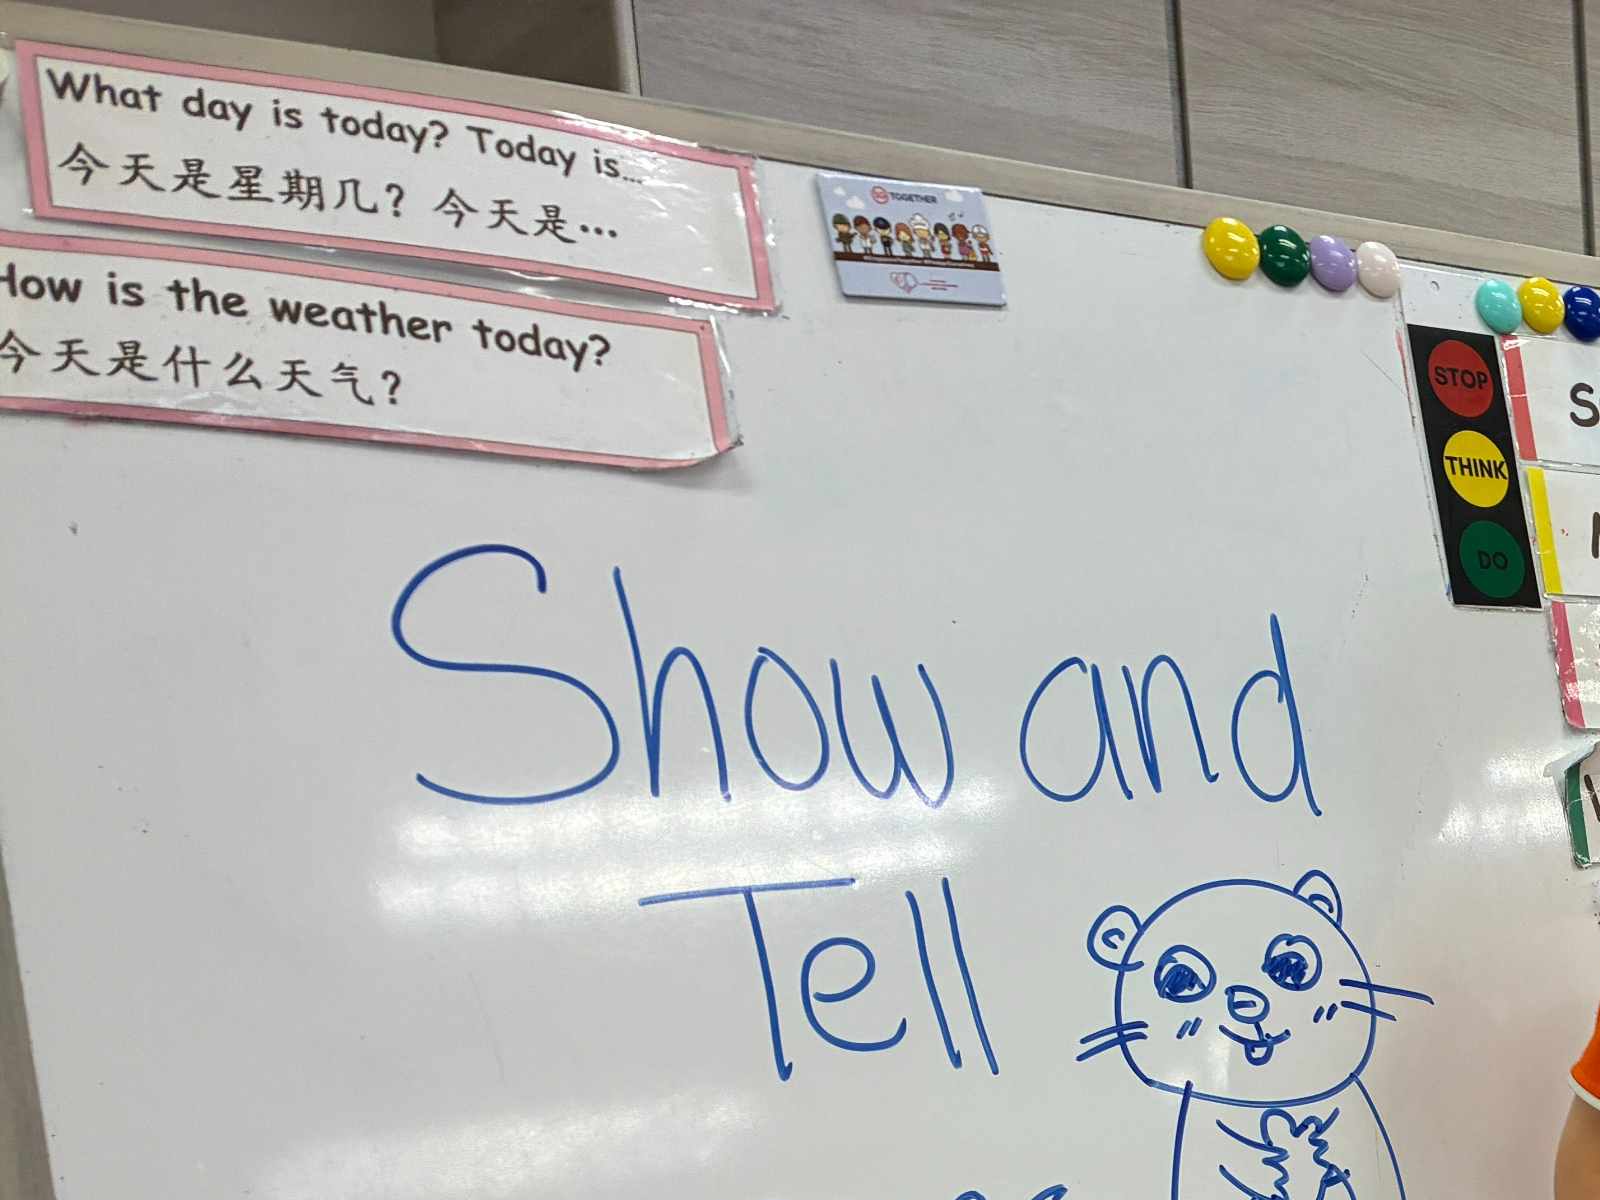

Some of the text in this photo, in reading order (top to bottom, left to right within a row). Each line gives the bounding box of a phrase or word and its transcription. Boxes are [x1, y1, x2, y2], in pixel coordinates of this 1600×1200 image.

[45, 67, 162, 113] What
[182, 87, 253, 132] day
[272, 98, 304, 130] is
[320, 106, 450, 151] today?
[466, 124, 577, 177] Today
[107, 270, 146, 308] is
[167, 277, 249, 318] the
[269, 297, 453, 344] weather
[471, 318, 612, 368] today?
[1434, 366, 1488, 391] STOP
[1445, 455, 1508, 481] THINK
[1477, 549, 1509, 571] DO
[390, 542, 1323, 818] Show and
[637, 876, 1001, 1082] Tell
